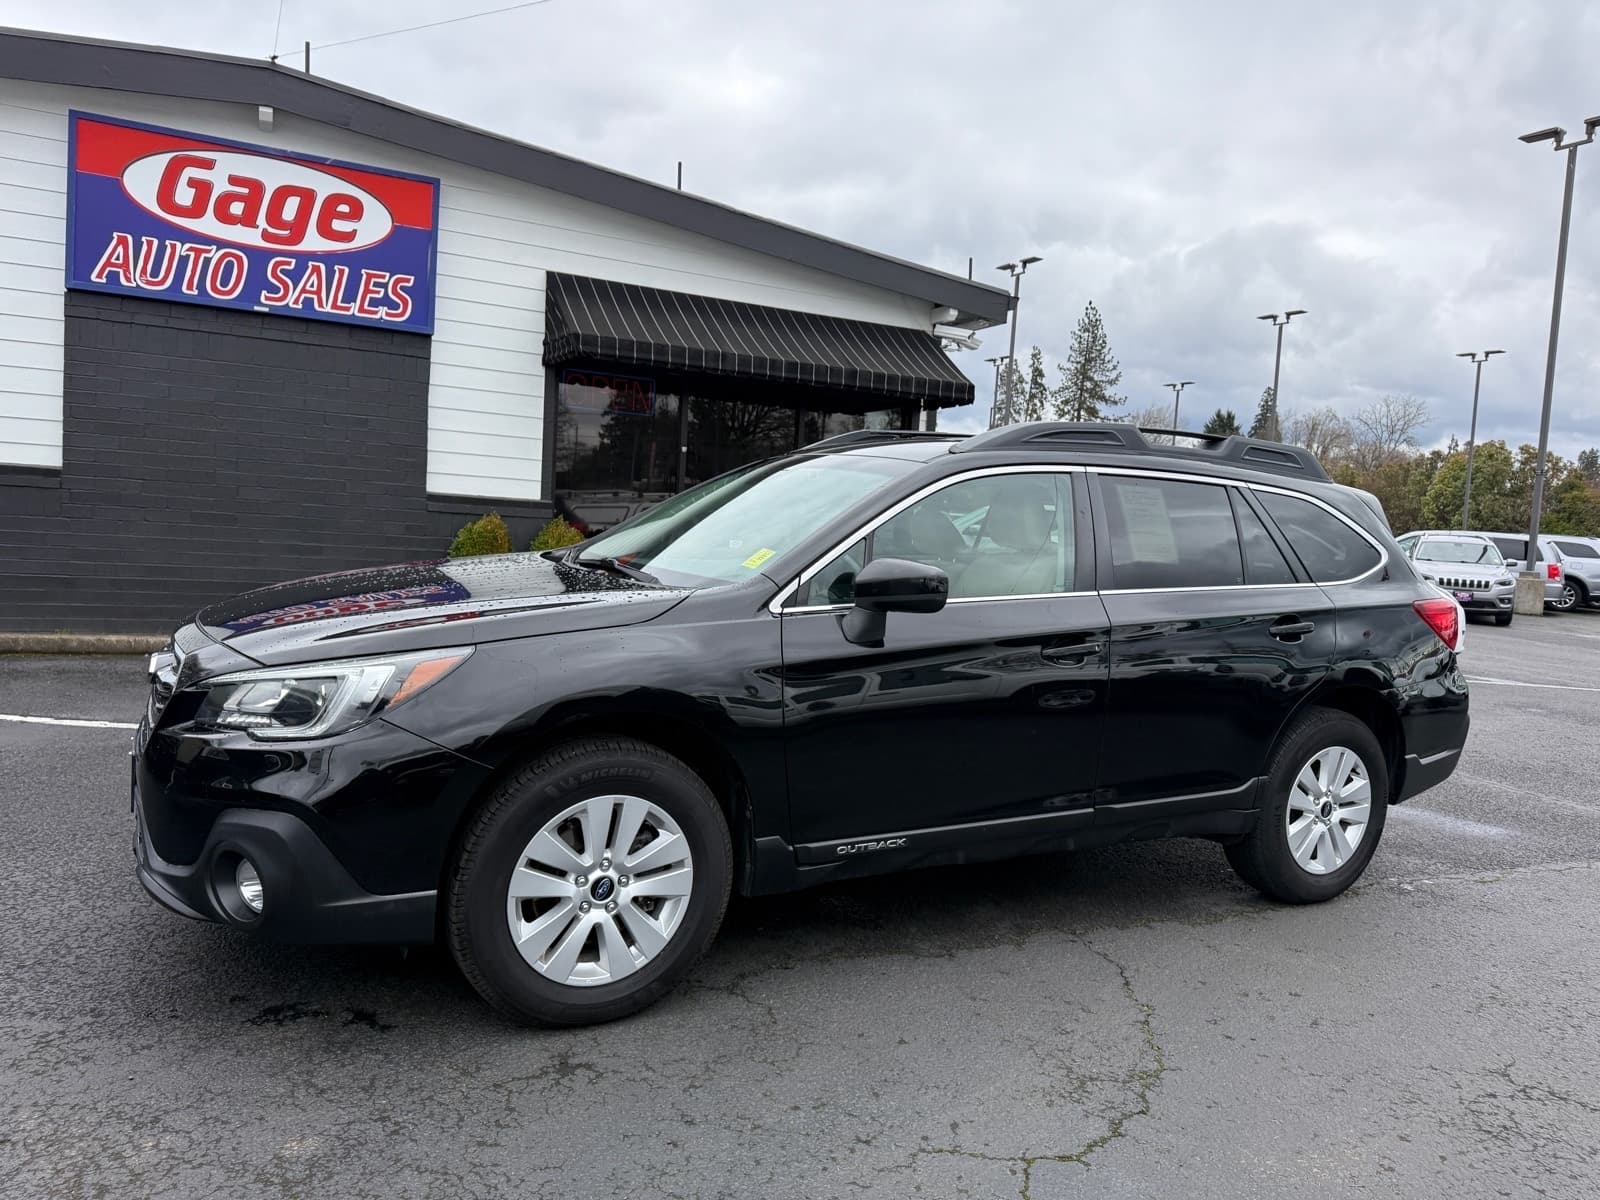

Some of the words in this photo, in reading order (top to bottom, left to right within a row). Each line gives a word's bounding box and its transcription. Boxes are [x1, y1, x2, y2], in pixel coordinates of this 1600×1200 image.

[156, 152, 364, 246] Gage
[91, 231, 248, 300] AUTO
[260, 256, 415, 322] SALES
[567, 373, 652, 411] OPEN
[836, 837, 907, 854] OUTBACK
